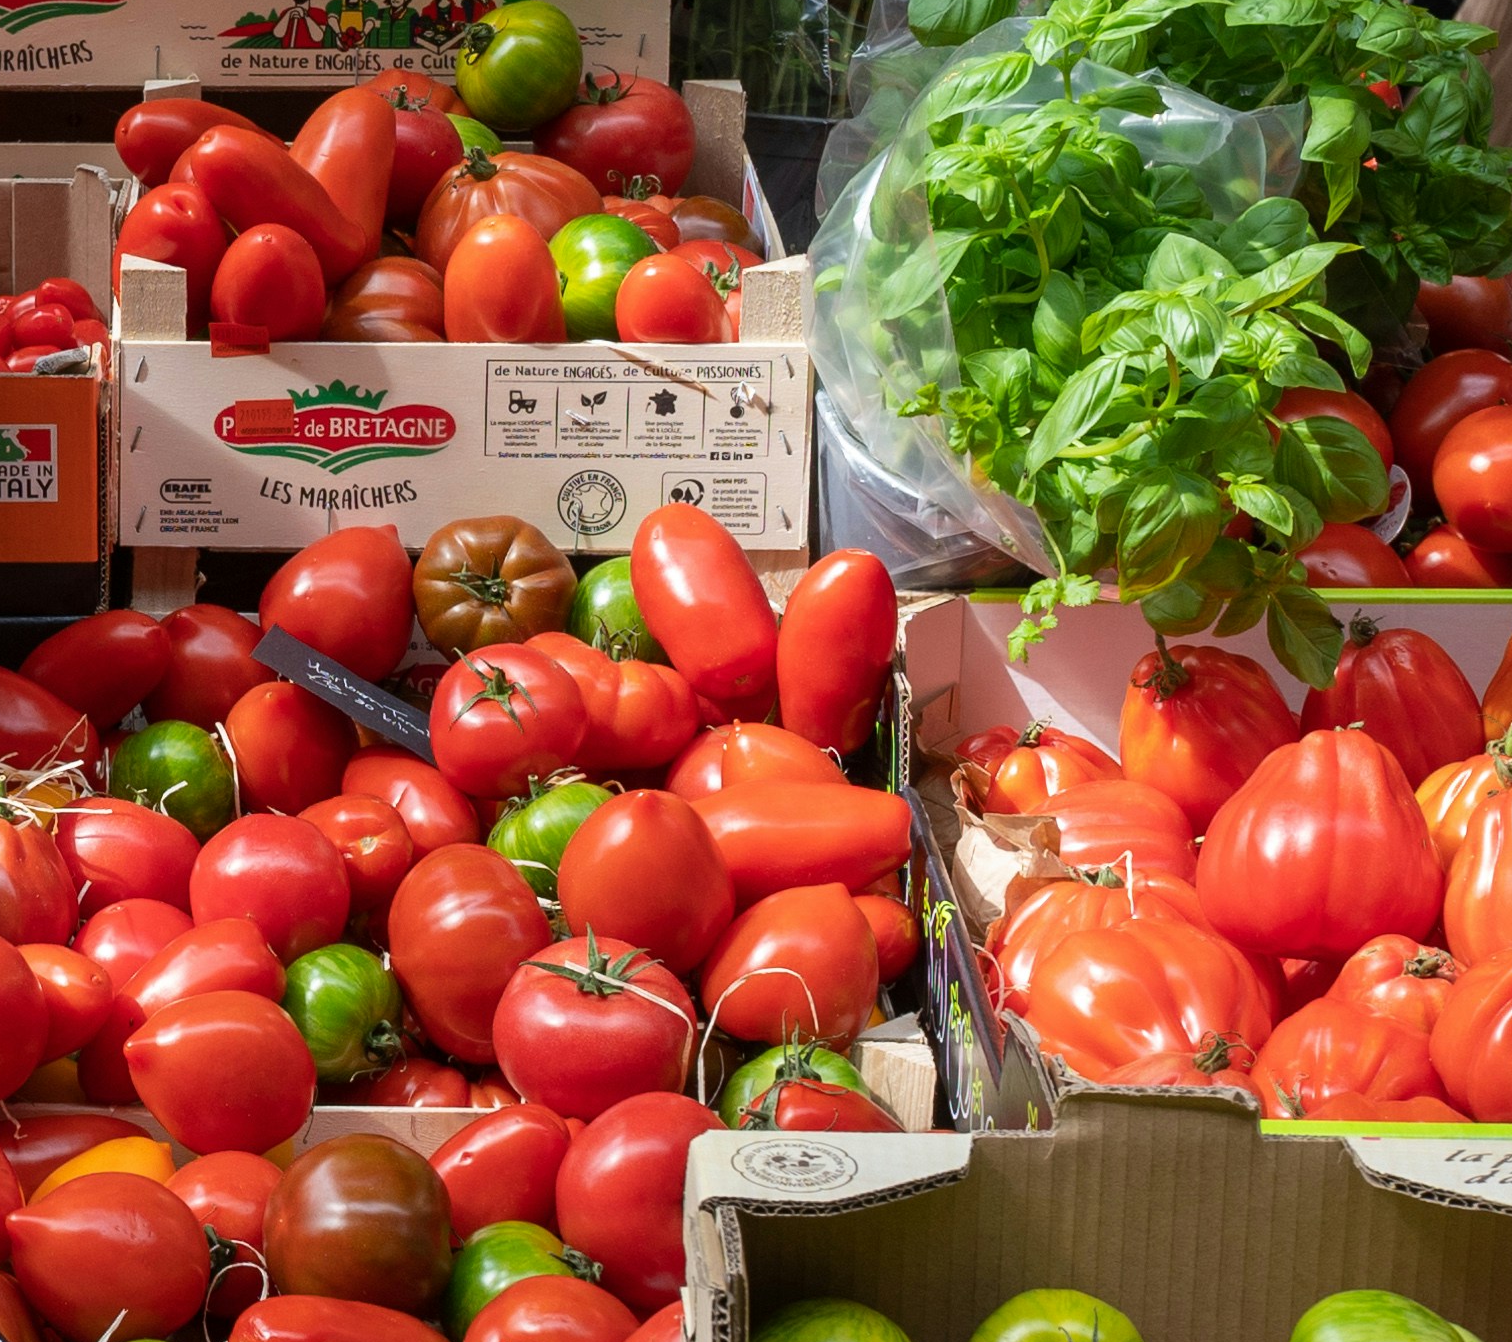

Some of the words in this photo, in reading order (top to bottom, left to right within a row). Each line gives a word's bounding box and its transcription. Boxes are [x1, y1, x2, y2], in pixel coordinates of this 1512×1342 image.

[494, 366, 510, 376] de
[515, 366, 559, 376] Nature
[623, 366, 638, 377] de
[304, 420, 325, 436] de
[329, 417, 447, 439] BRETAGNE
[37, 465, 53, 476] IN
[165, 484, 211, 493] ERAFEL
[260, 477, 292, 505] LES
[299, 479, 418, 510] MARAÎCHERS
